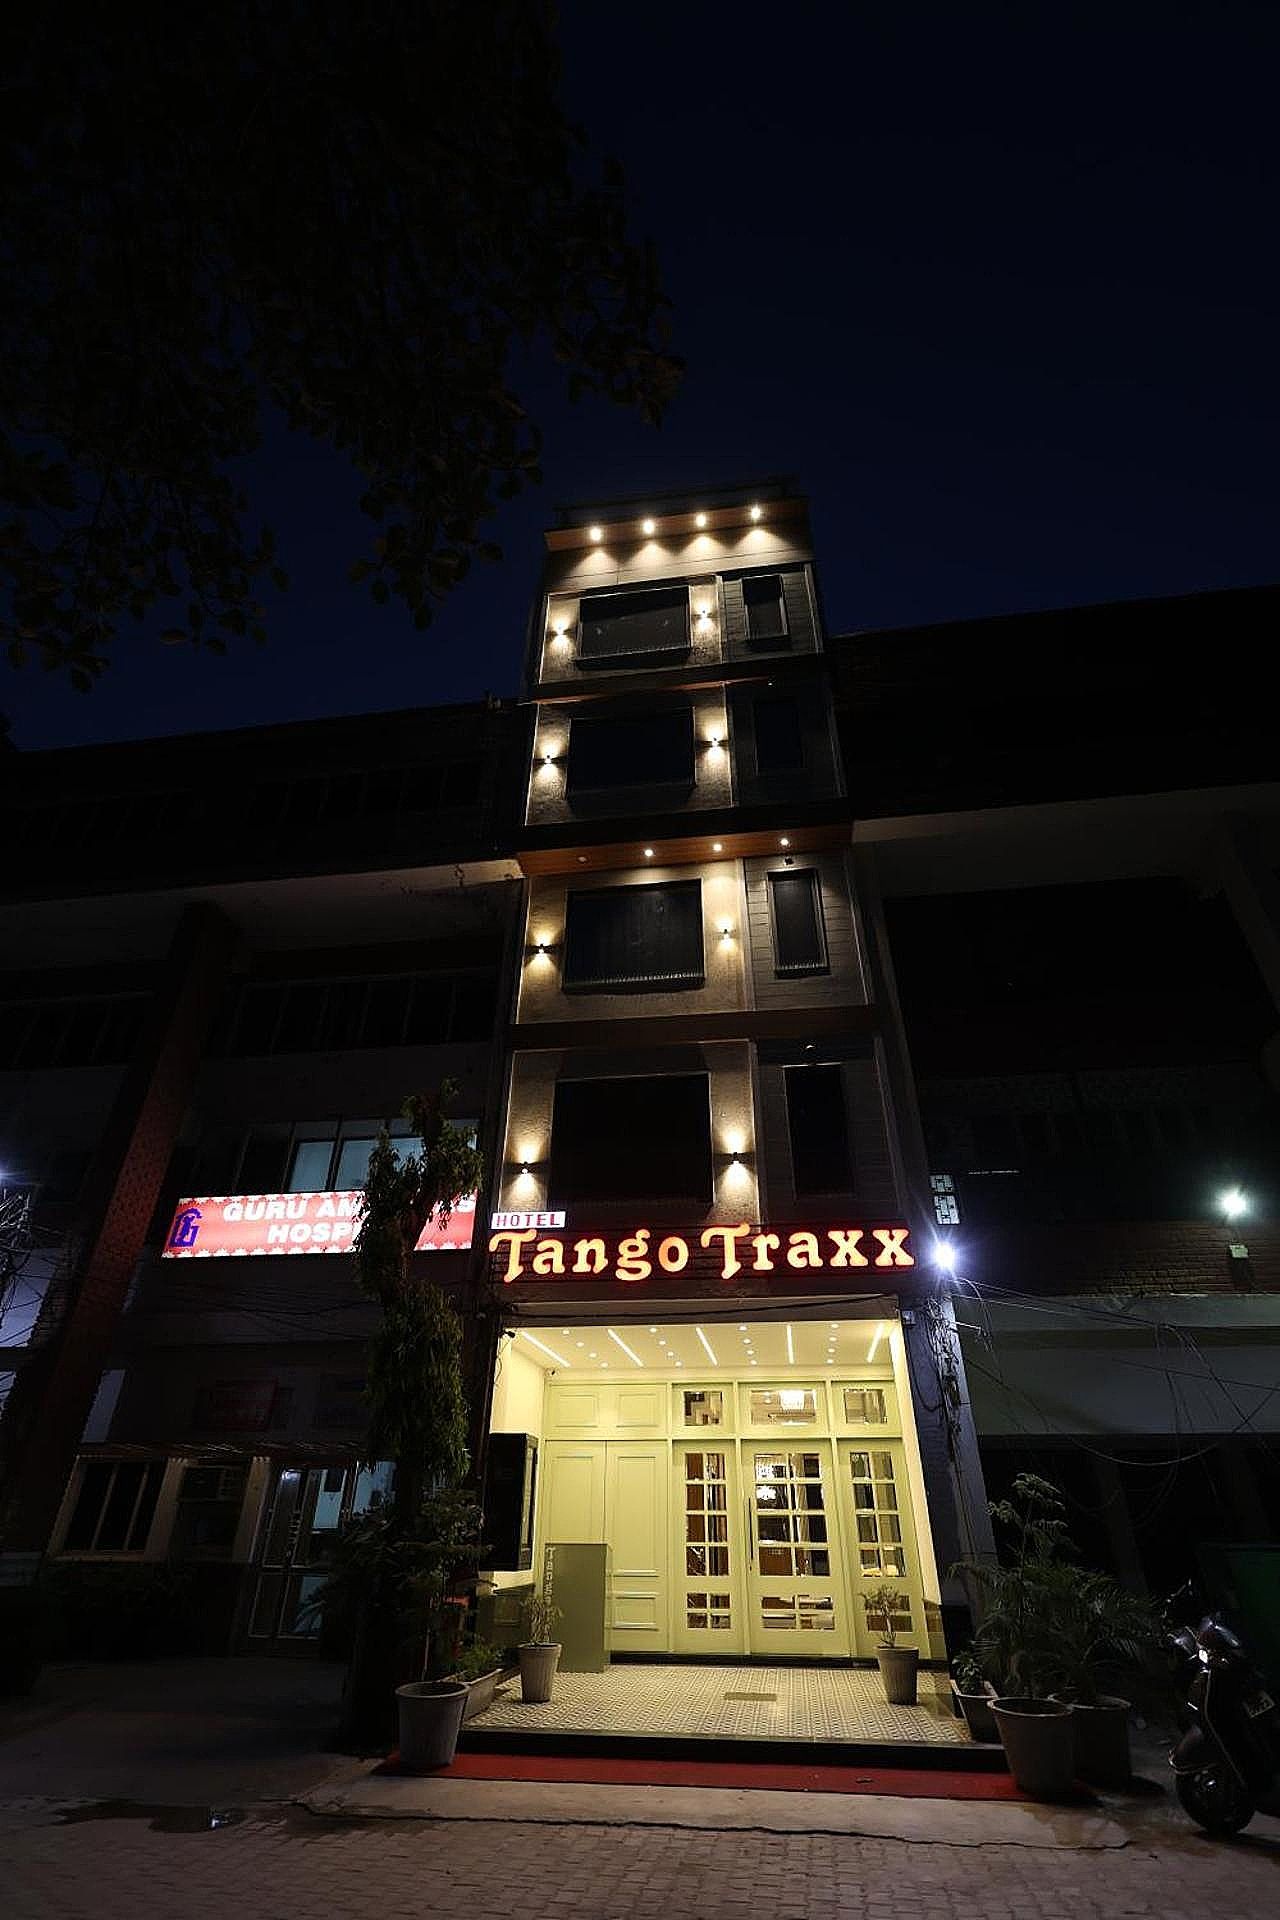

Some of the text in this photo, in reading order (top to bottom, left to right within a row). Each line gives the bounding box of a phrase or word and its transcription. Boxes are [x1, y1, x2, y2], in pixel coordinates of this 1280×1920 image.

[223, 1201, 307, 1221] GURU
[496, 1213, 561, 1227] HOTEL
[489, 1223, 914, 1283] Tango Traxx
